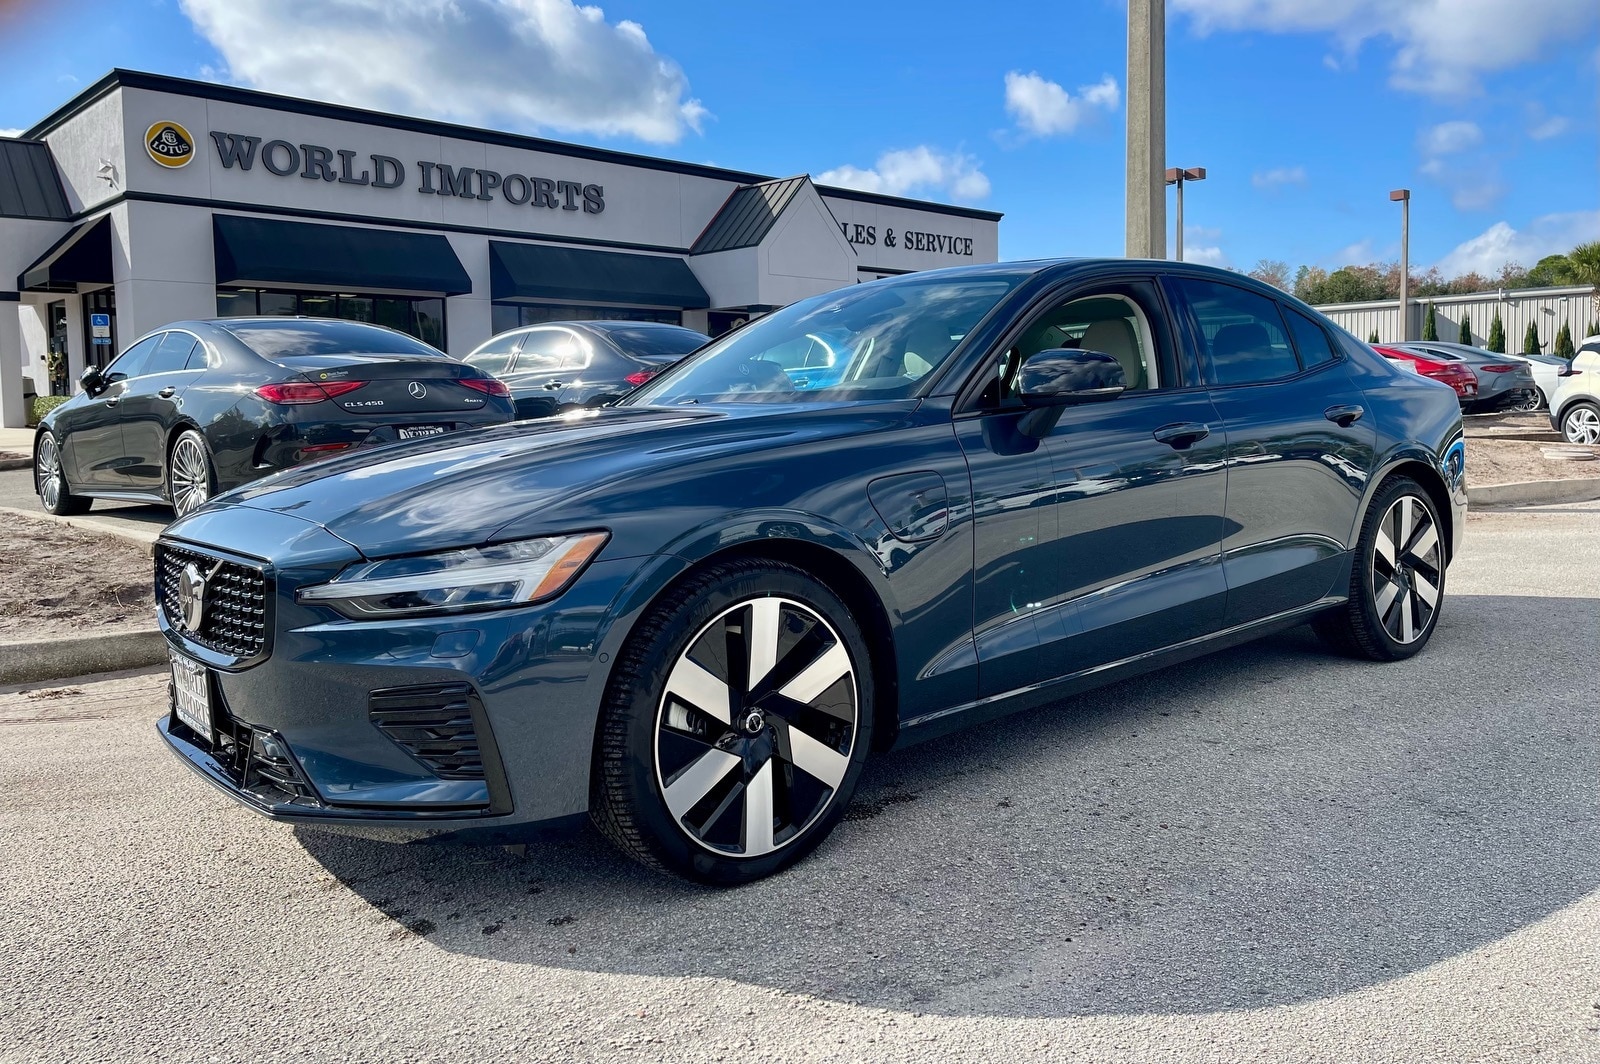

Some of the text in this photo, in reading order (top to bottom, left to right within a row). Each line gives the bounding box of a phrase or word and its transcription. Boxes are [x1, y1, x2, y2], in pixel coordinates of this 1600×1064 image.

[152, 141, 189, 154] LOTUS
[210, 131, 606, 214] WORLD IMPORTS
[841, 222, 973, 256] LES & SERVICE
